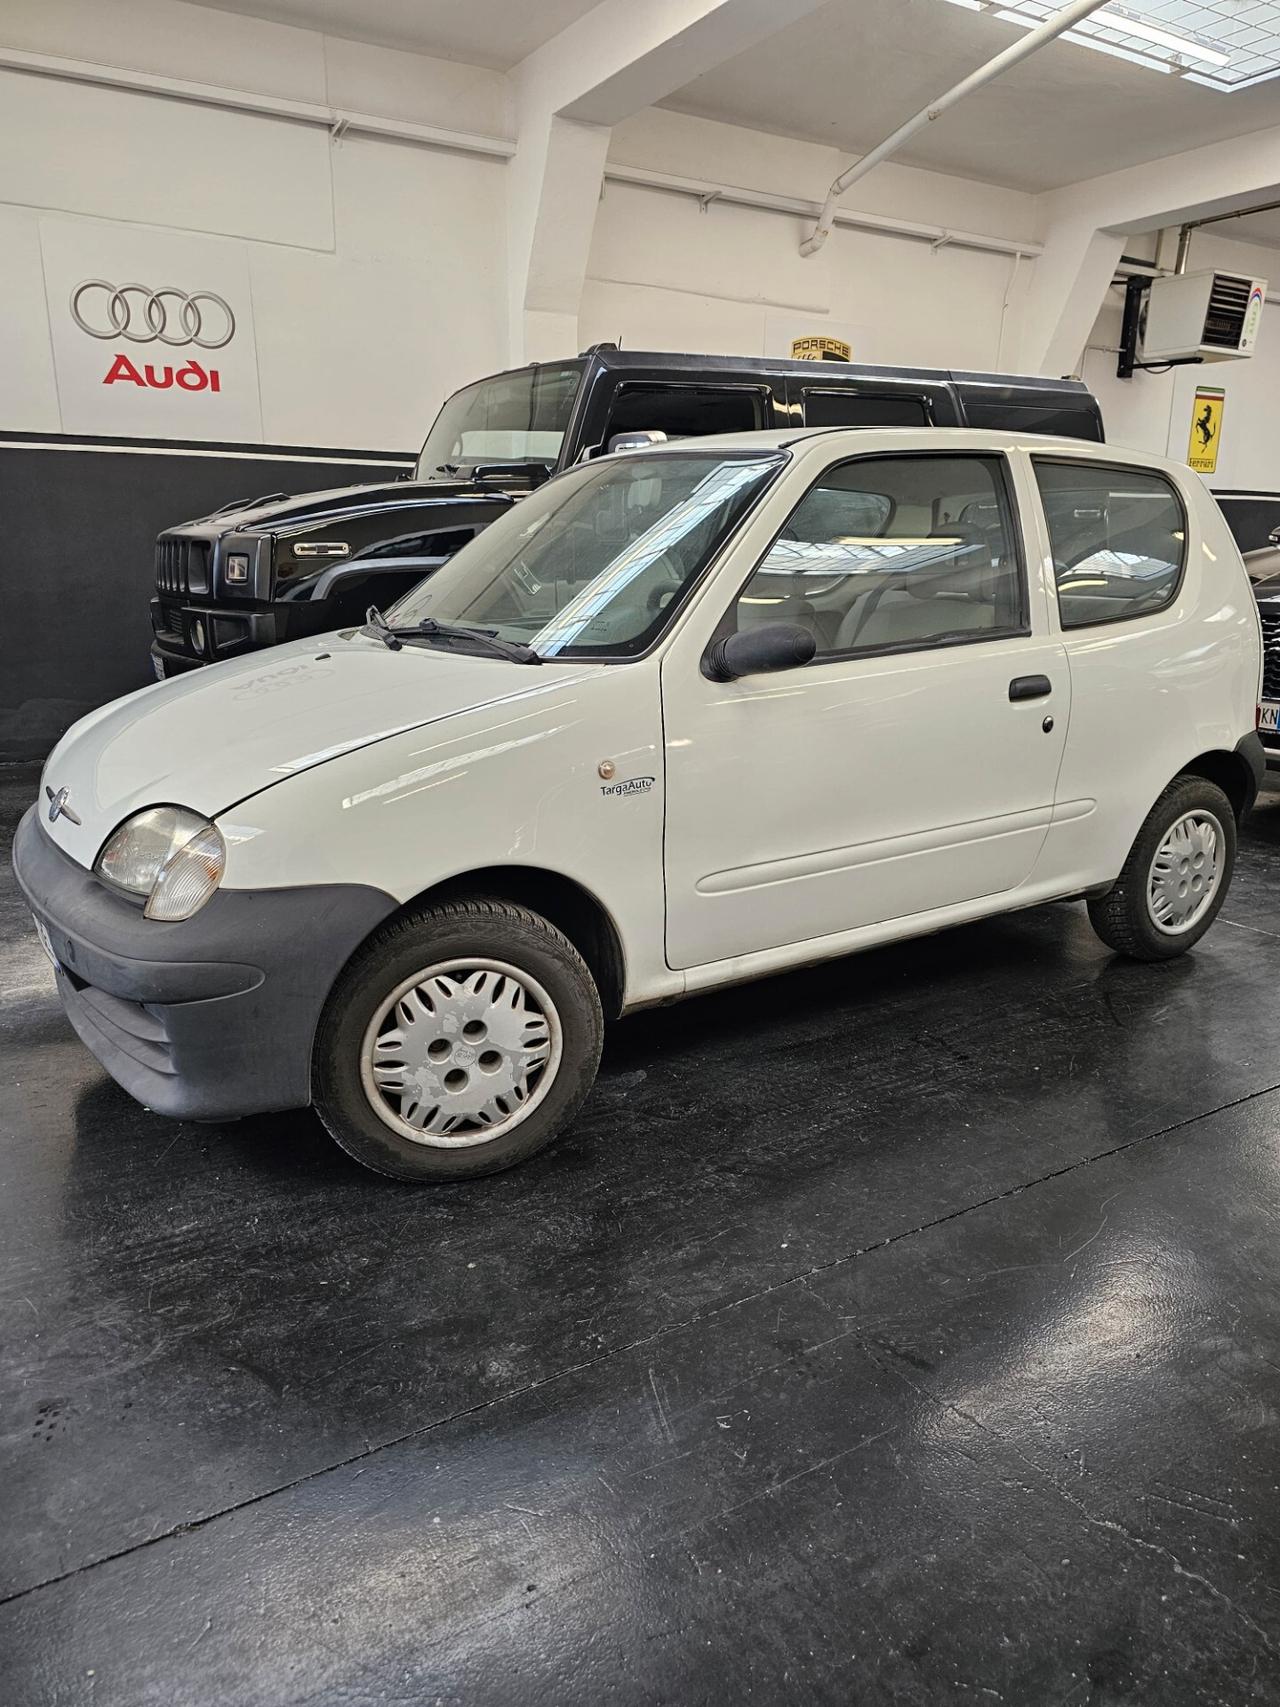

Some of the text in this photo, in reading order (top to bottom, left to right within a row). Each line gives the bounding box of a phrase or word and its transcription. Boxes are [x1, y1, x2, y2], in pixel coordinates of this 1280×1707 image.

[793, 339, 849, 358] PORSCHE
[102, 353, 221, 392] Audi
[1189, 457, 1214, 468] Ferrari
[600, 779, 652, 796] TargaAuto
